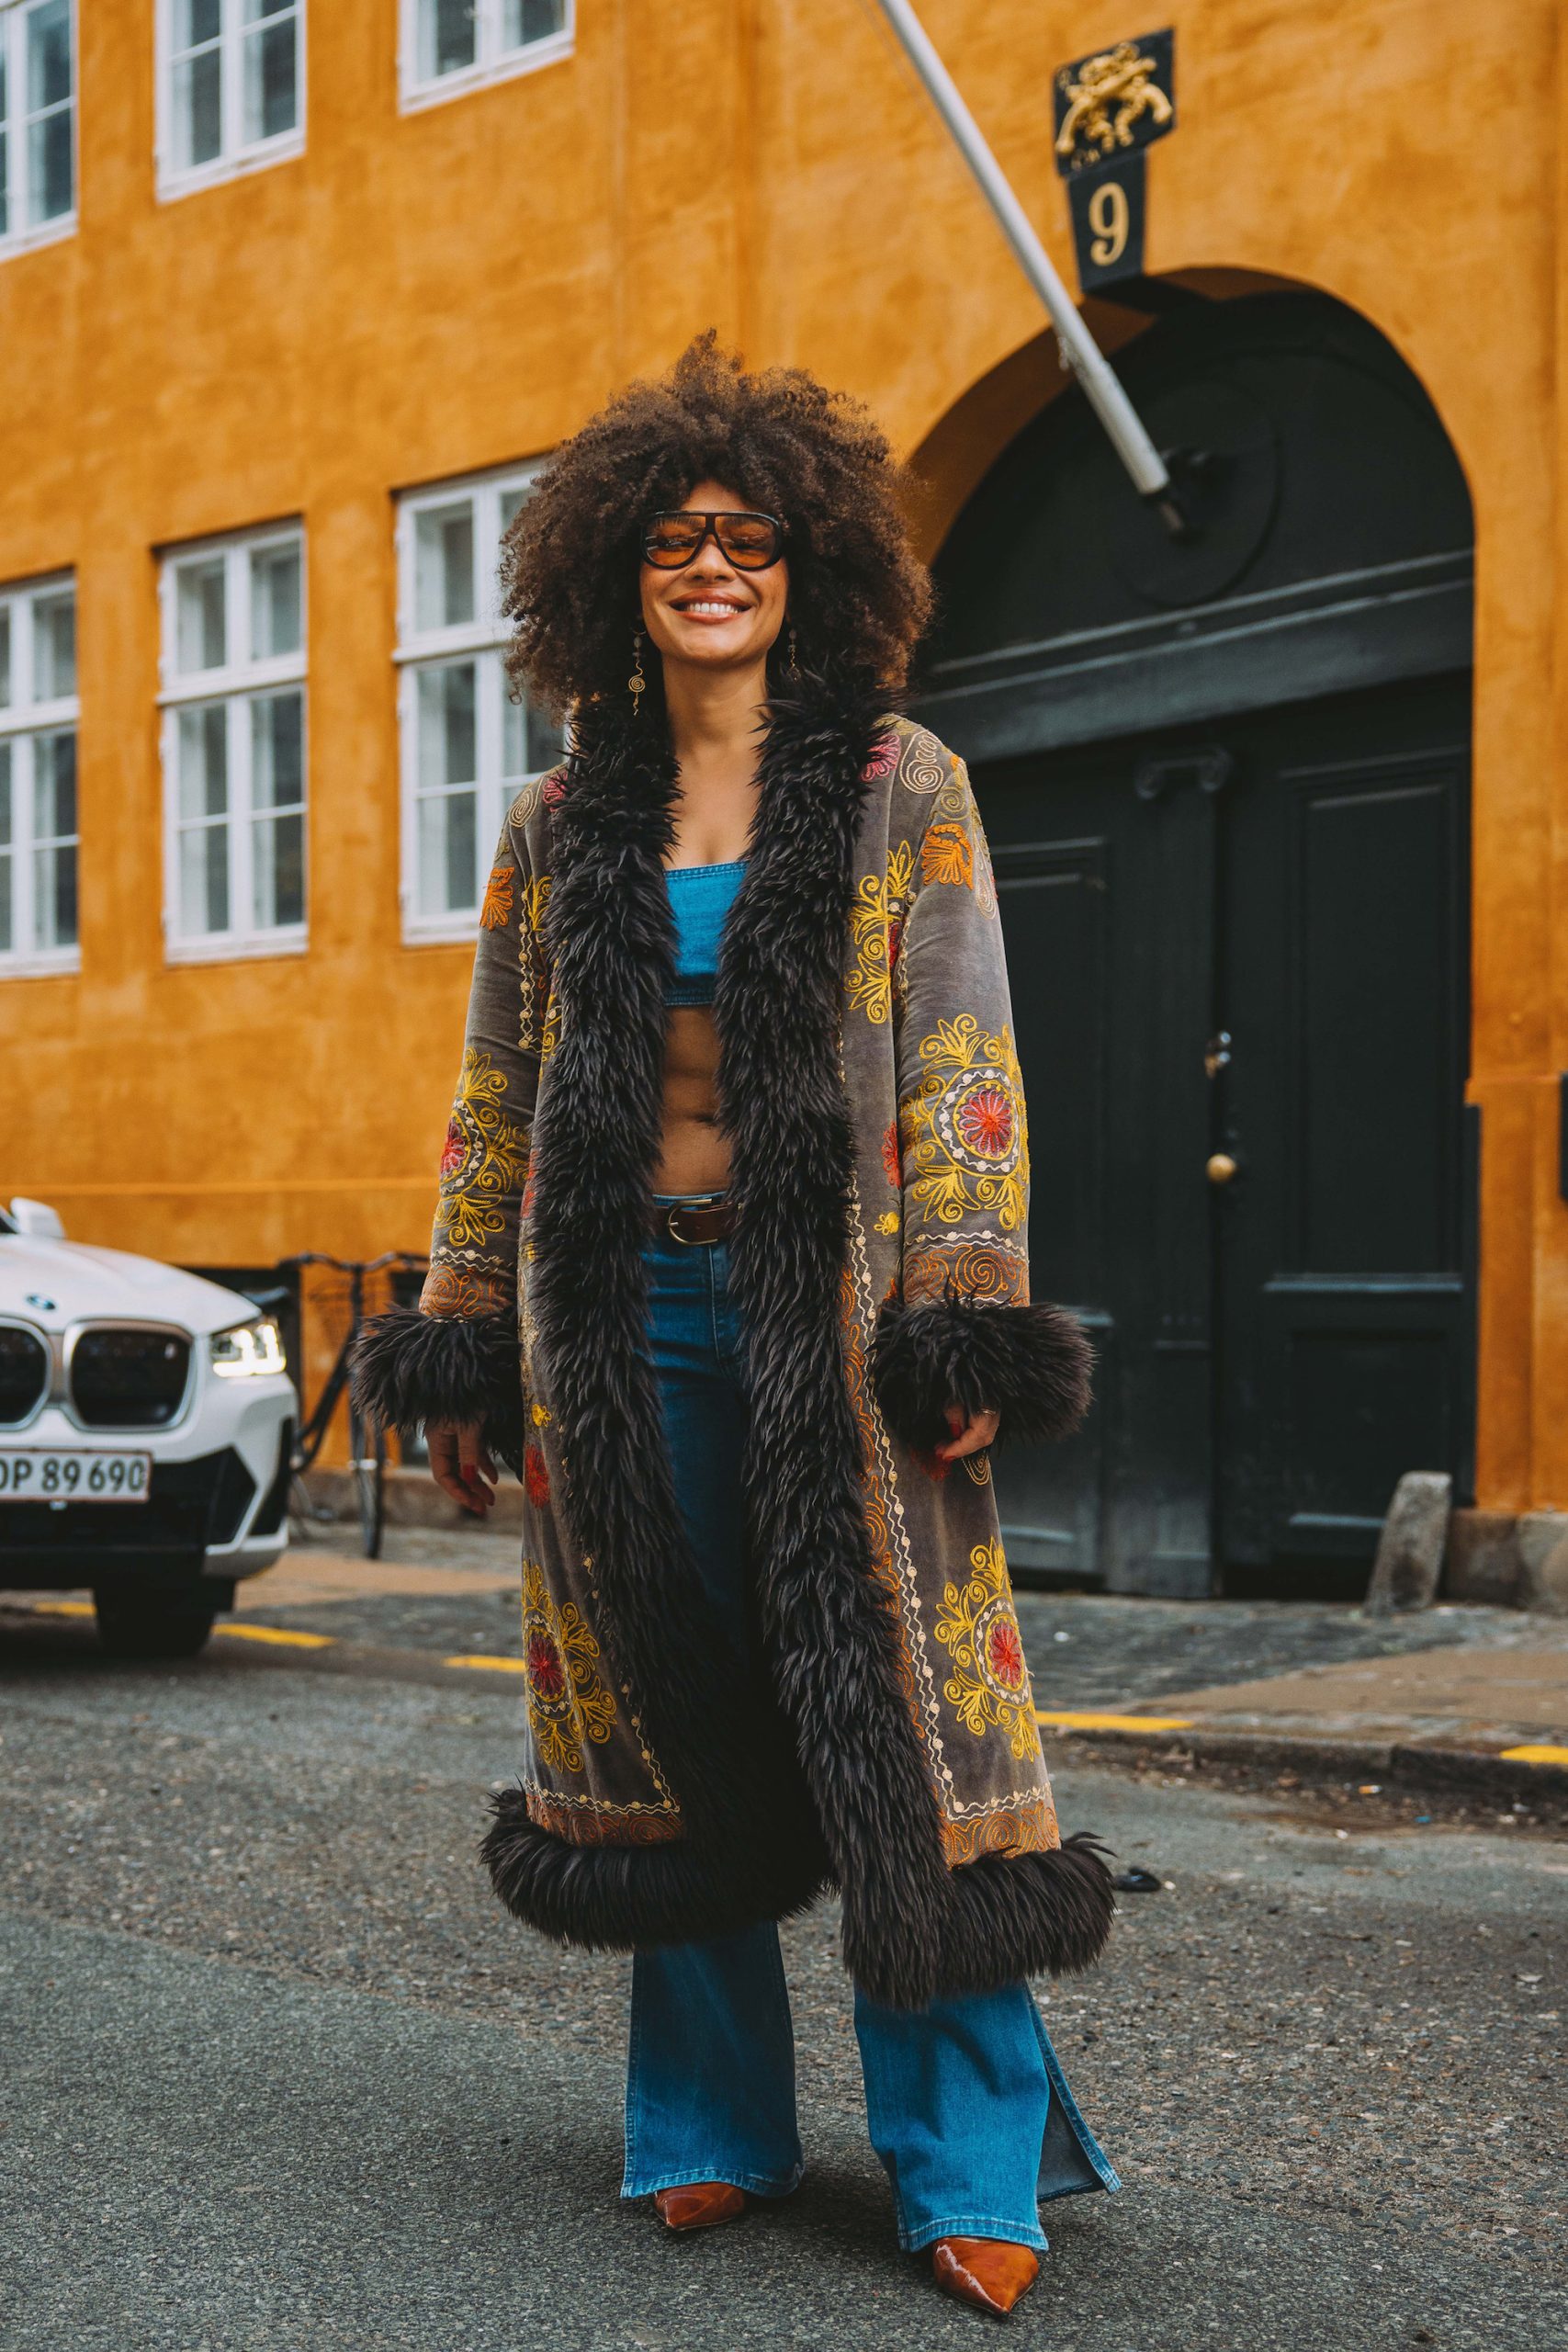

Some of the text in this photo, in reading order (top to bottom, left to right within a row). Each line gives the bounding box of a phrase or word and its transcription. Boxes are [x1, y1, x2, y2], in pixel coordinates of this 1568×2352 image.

[1089, 181, 1130, 266] 9
[41, 1458, 81, 1493] 89
[88, 1458, 145, 1492] 690
